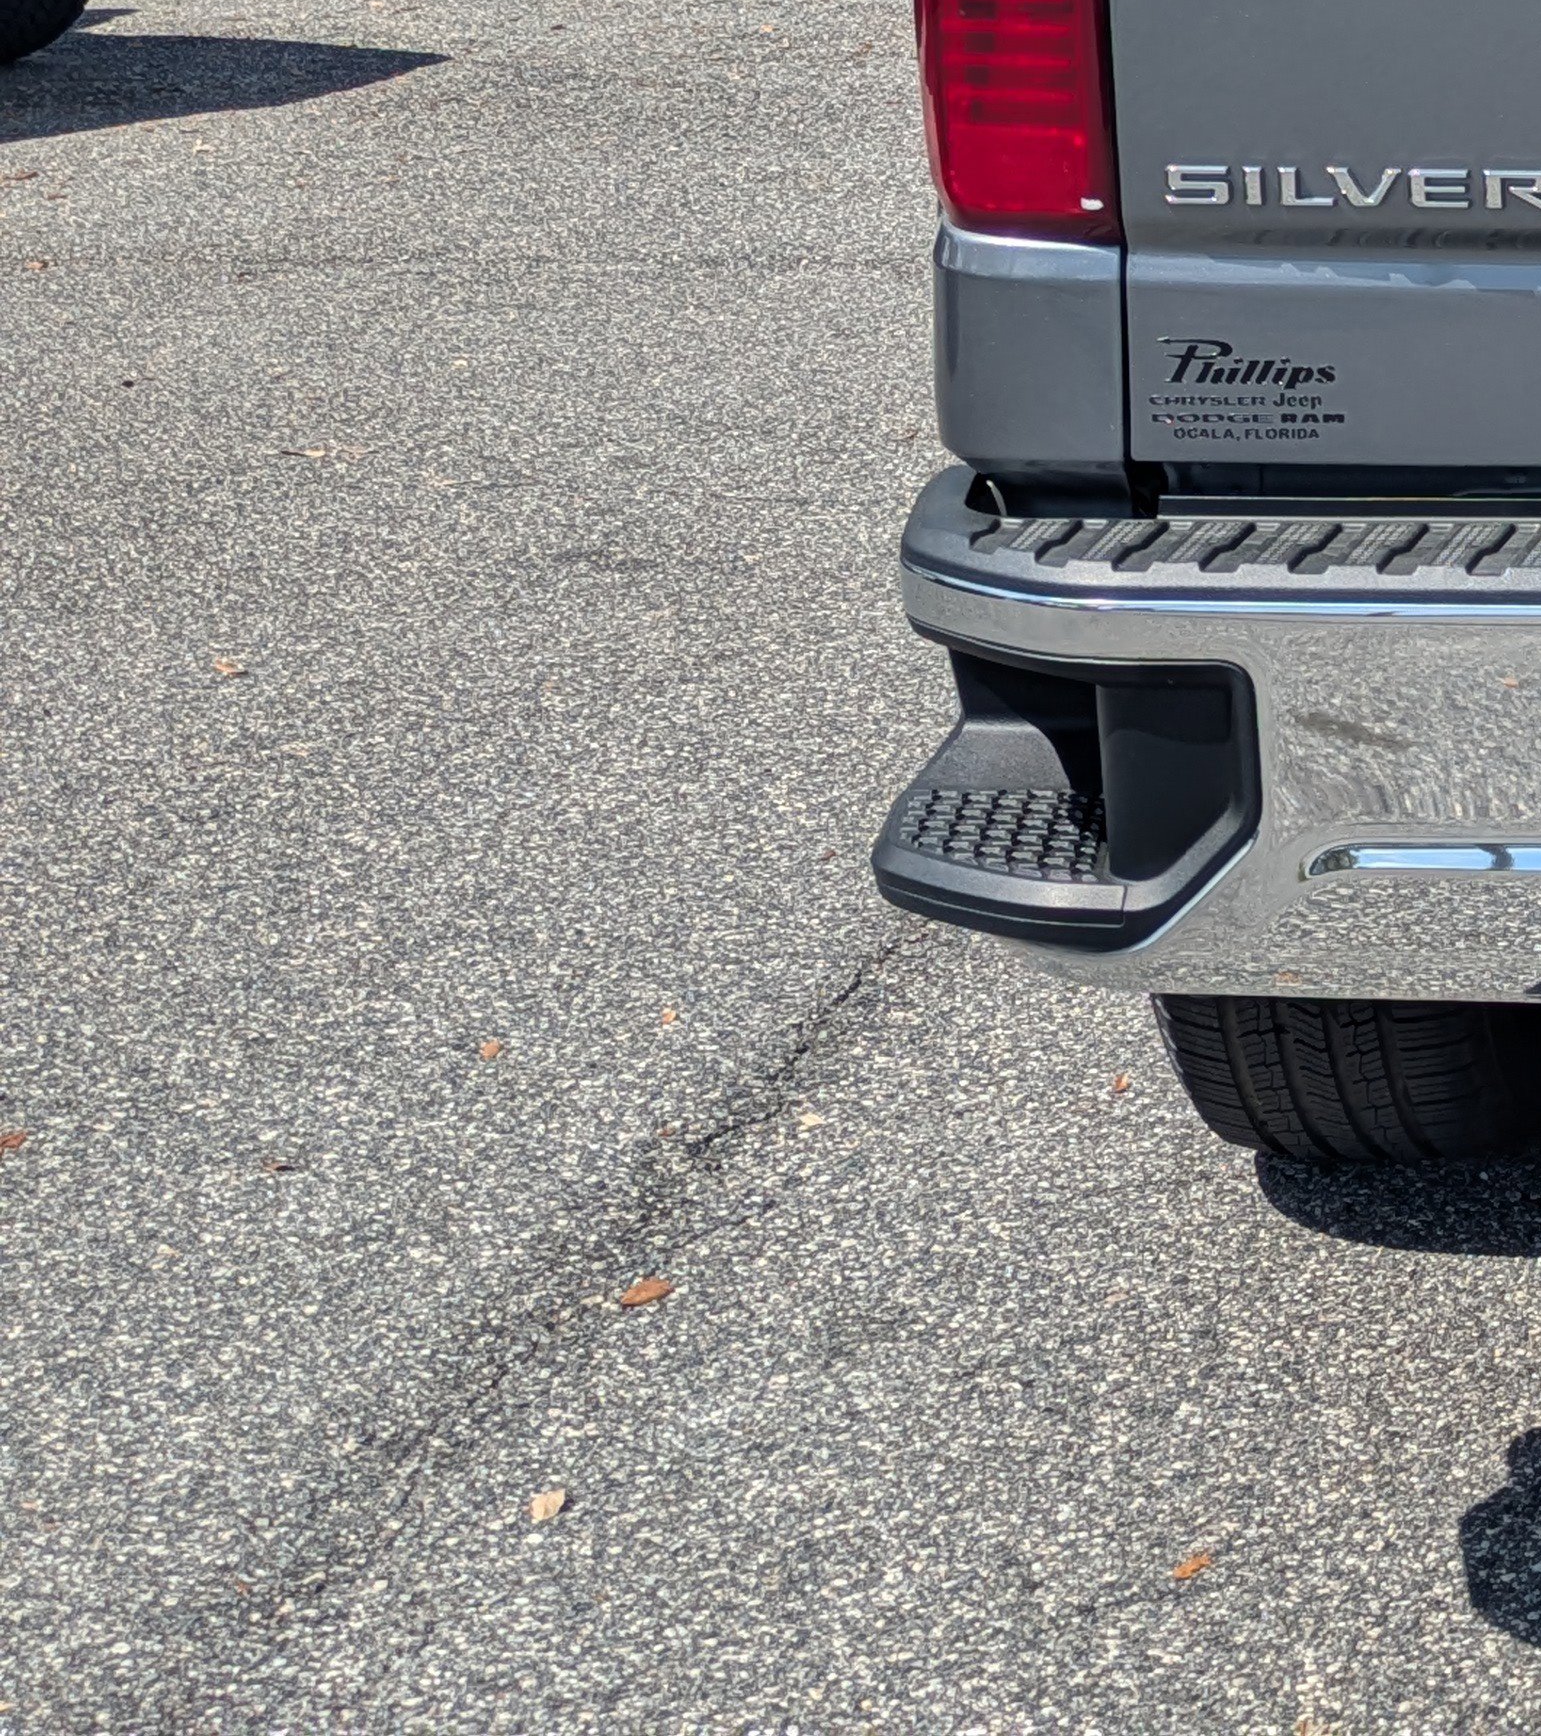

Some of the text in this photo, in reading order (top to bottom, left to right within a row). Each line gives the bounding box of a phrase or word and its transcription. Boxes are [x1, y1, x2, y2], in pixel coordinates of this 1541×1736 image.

[1156, 336, 1336, 390] Phillips
[1149, 392, 1322, 410] CHRYSLER Jeep
[1152, 413, 1346, 424] DODGE RAM
[1173, 427, 1320, 442] OCALA, FLORIDA
